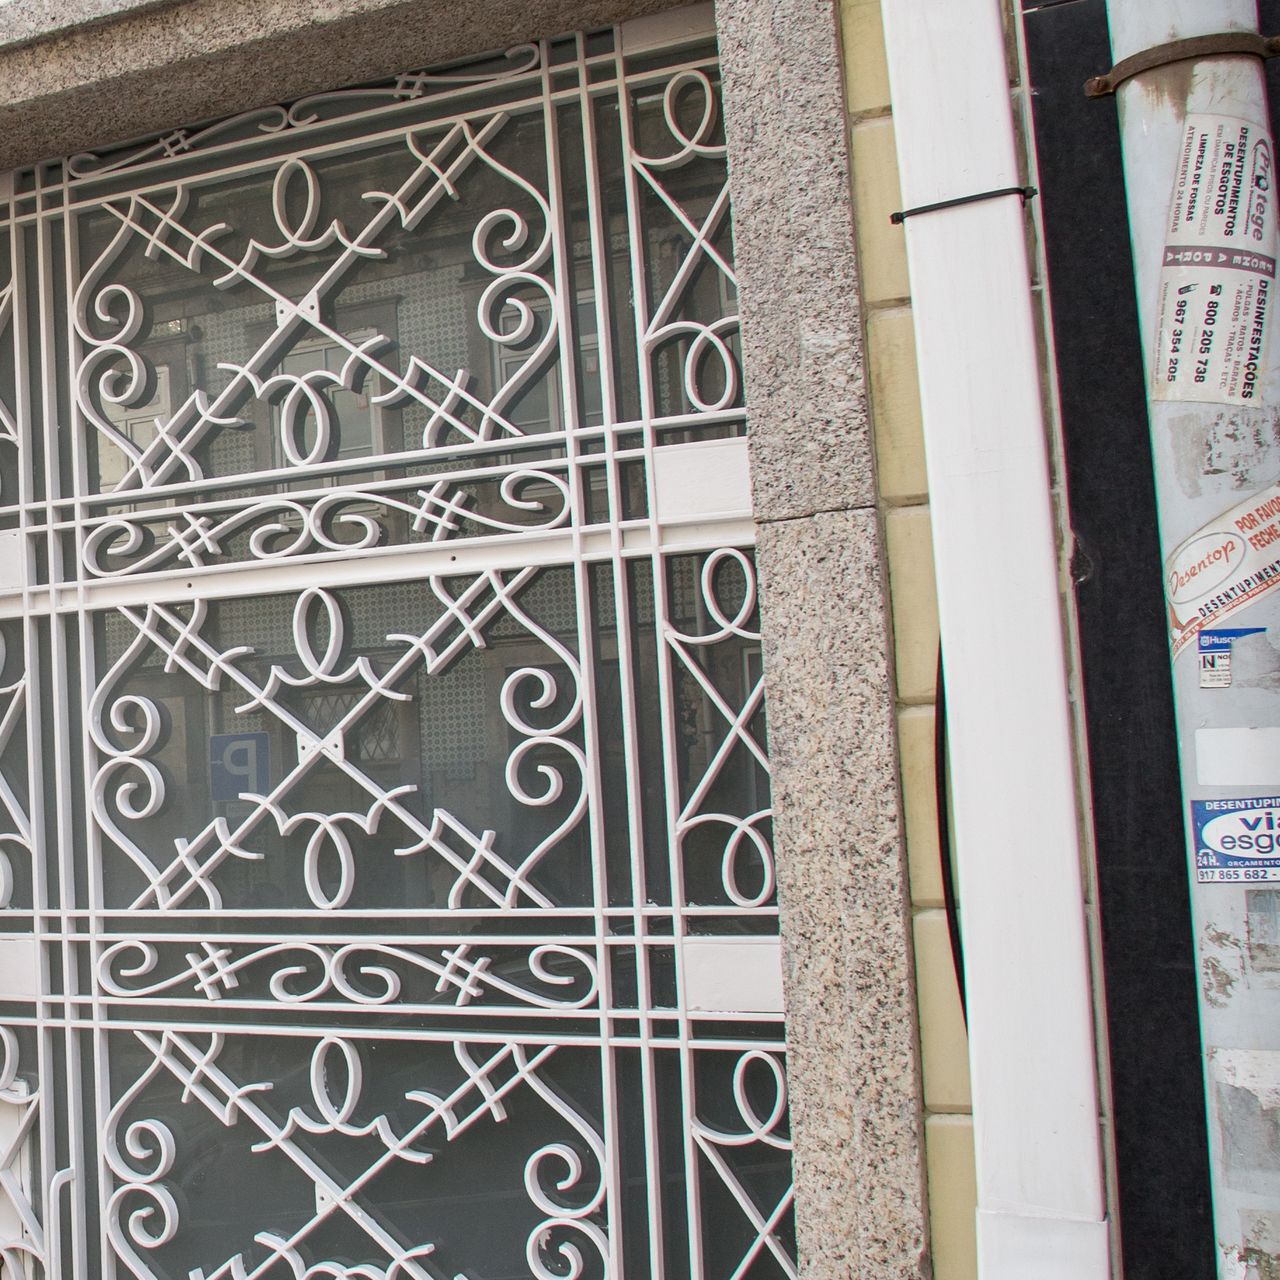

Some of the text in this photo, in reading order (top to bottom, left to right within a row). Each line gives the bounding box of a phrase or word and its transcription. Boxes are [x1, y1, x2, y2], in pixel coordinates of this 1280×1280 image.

[1171, 126, 1195, 233] ATENDIMENTO 24 HORAS
[1185, 133, 1208, 222] LIMPEZA DE FOSSAS
[1214, 144, 1235, 215] DE ESGOTOS
[1224, 127, 1248, 236] DESENTUPIMENTOS
[1166, 251, 1273, 273] FECHE A PORTA
[1167, 300, 1187, 382] 967 354 205
[1194, 301, 1219, 384] 800 205 738
[1223, 331, 1236, 363] TRAÇAS
[1228, 285, 1253, 397] PULGAS RATOS BARATAS
[1234, 513, 1259, 533] POR
[1248, 524, 1280, 551] FECHE
[1170, 540, 1236, 597] Desentop
[1202, 654, 1216, 669] N
[1199, 870, 1215, 880] 917
[1218, 870, 1240, 880] 865
[1244, 869, 1268, 880] 682
